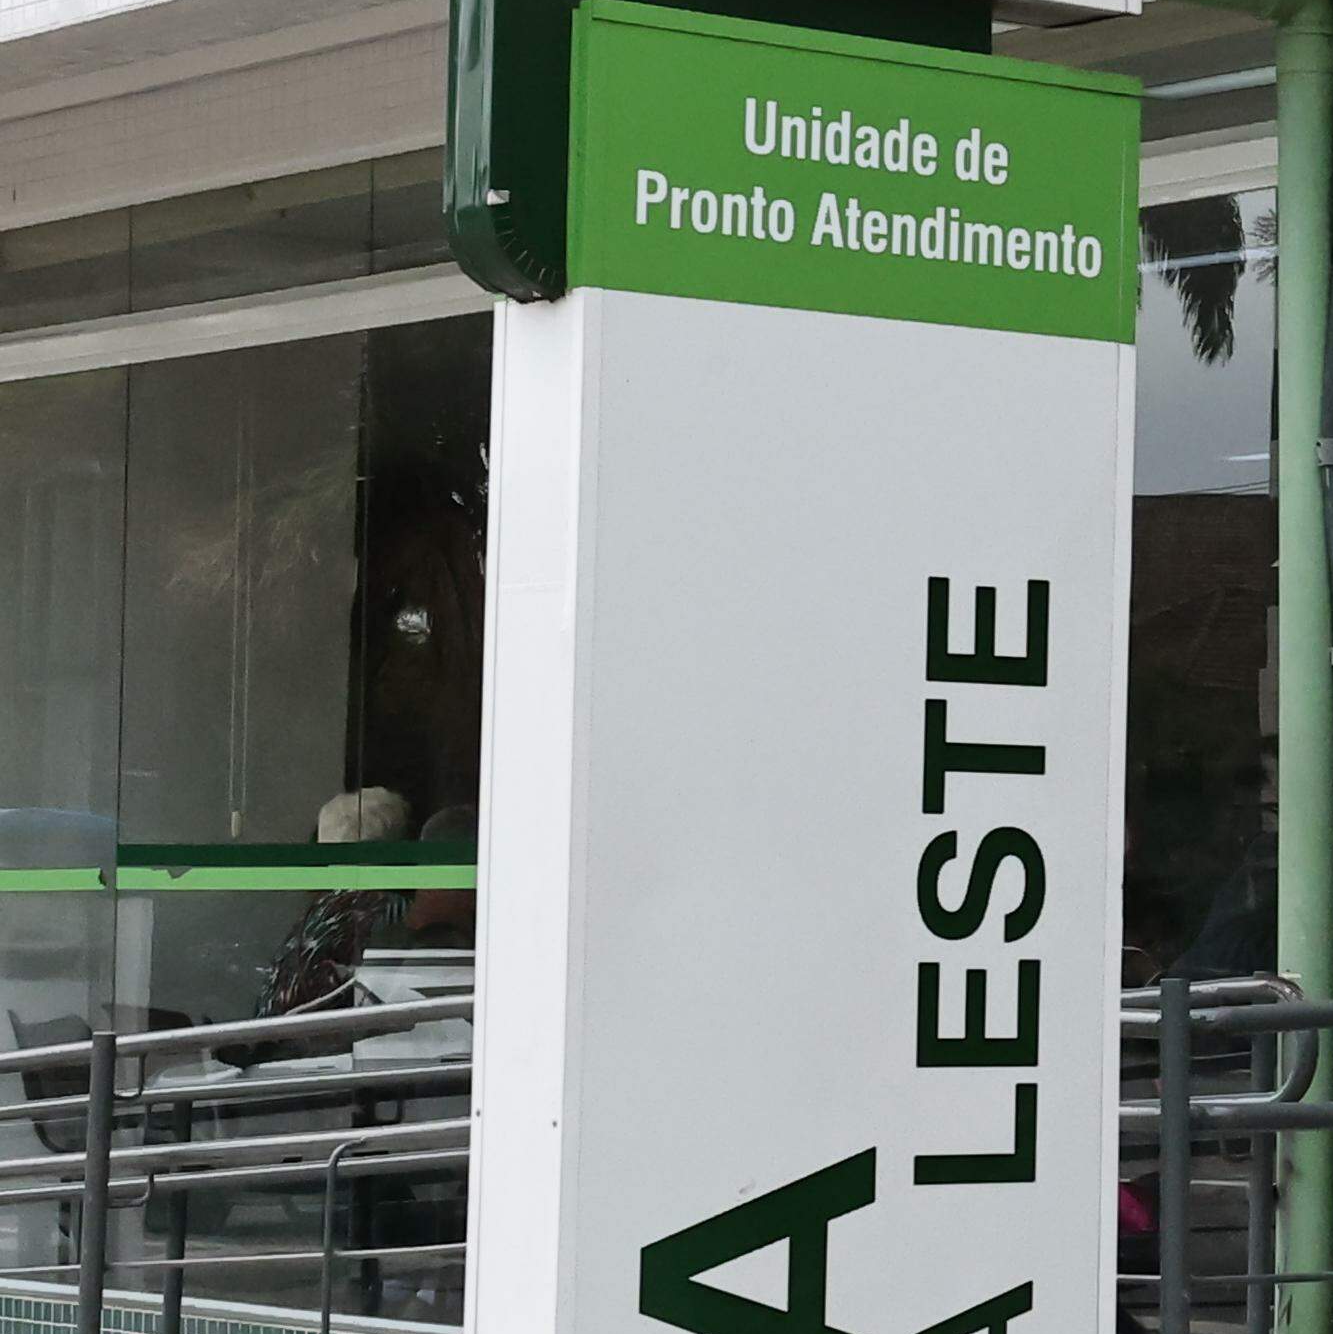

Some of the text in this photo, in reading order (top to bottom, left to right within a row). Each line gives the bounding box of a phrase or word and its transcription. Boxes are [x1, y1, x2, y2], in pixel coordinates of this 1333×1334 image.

[744, 96, 1010, 185] Unidade de
[634, 168, 1103, 279] Pronto Atendimento
[912, 575, 1050, 1186] LESTE
